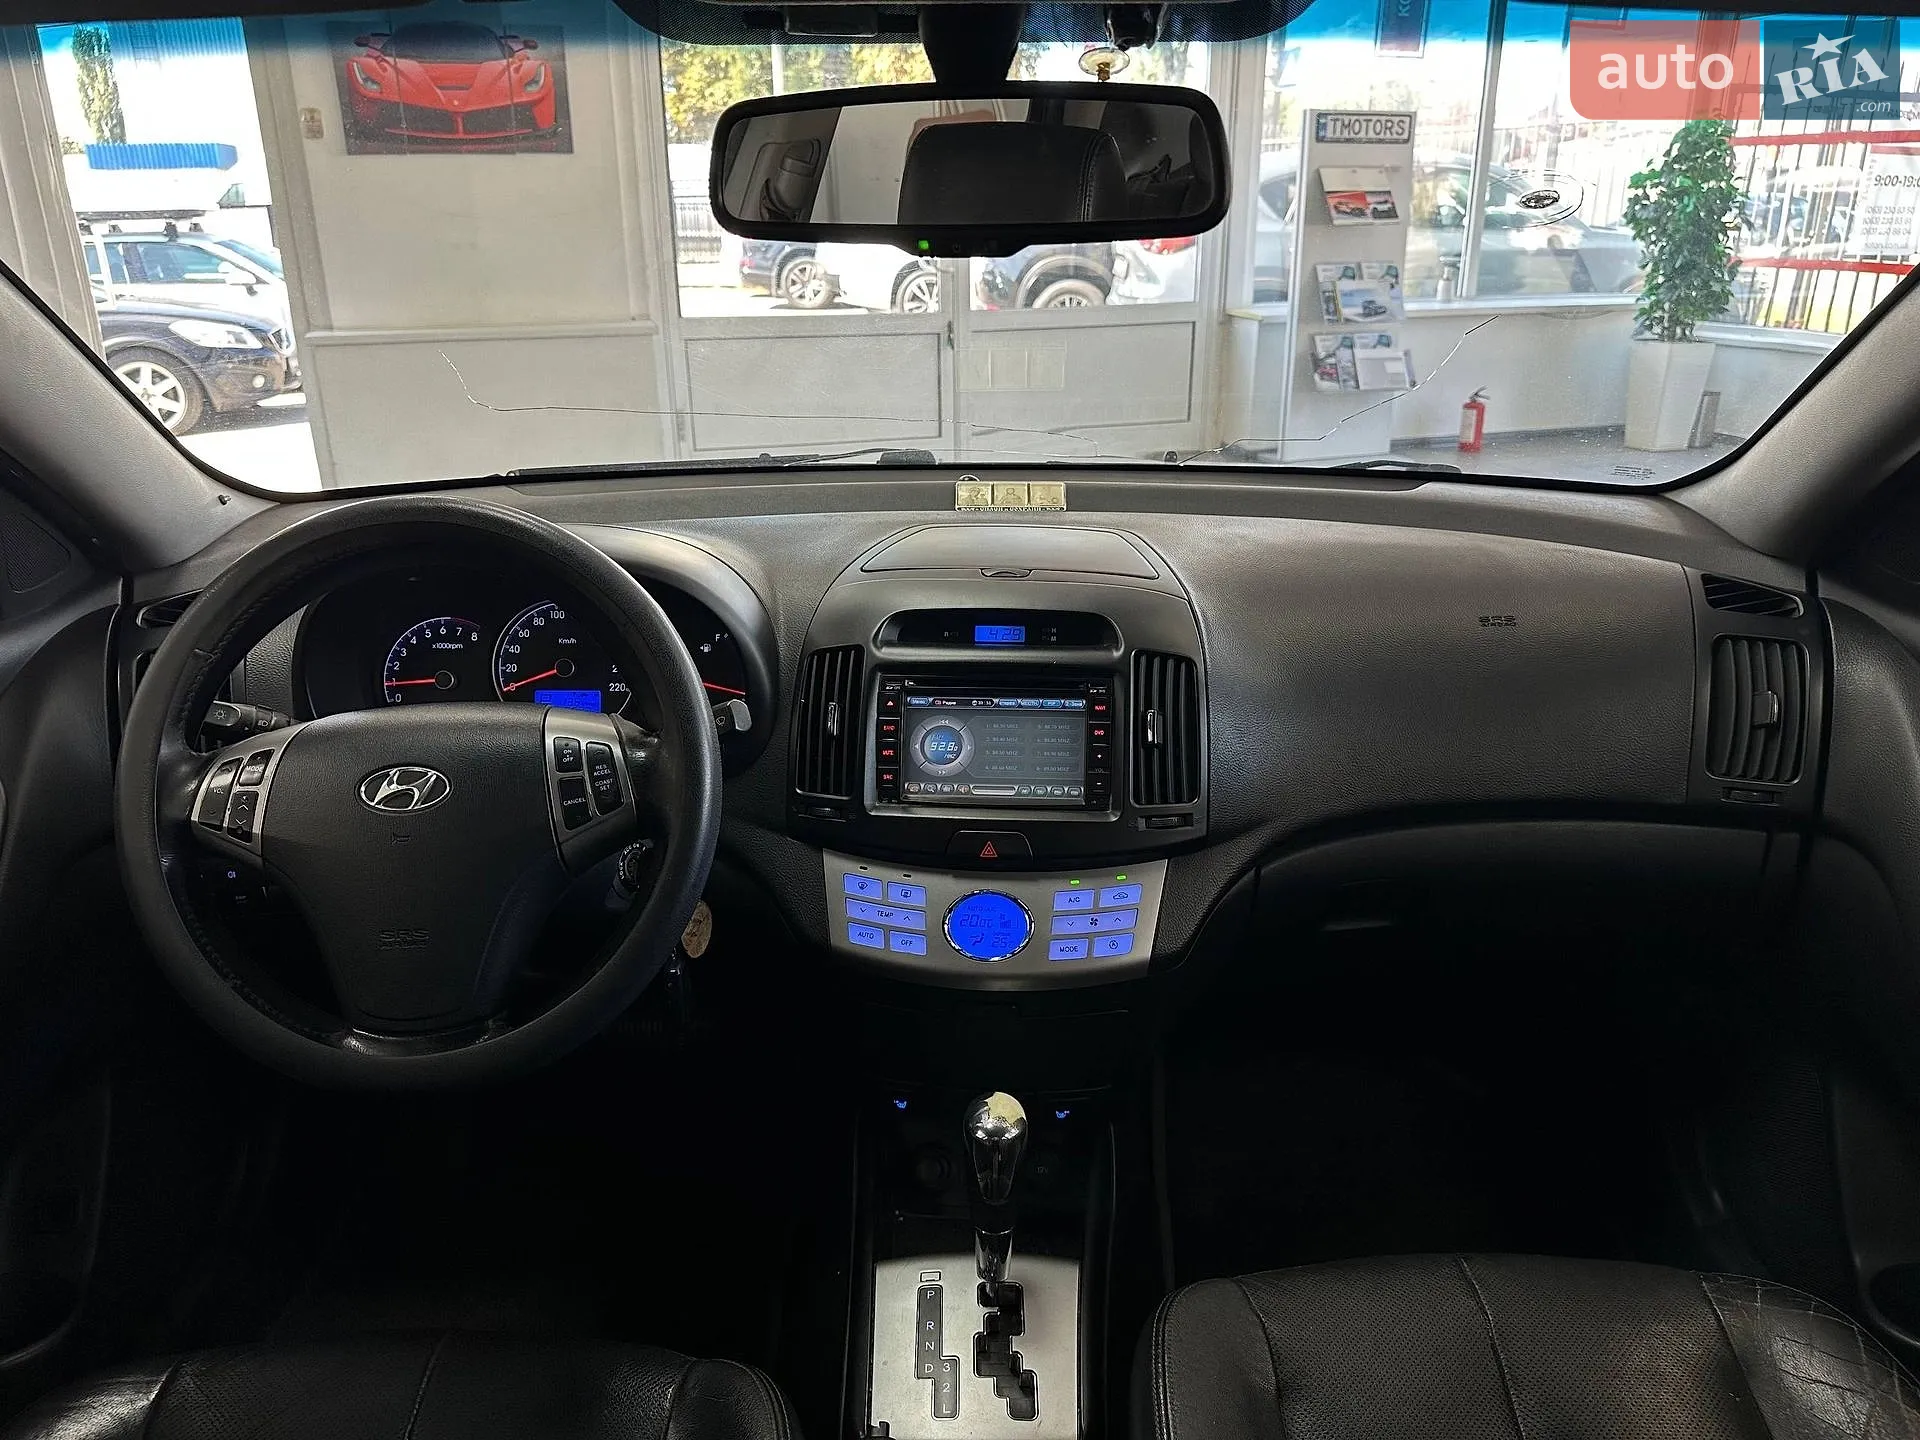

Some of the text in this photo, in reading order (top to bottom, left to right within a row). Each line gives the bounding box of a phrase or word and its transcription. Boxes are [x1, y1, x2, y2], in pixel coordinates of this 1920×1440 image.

[1329, 118, 1406, 137] TMOTORS
[549, 610, 565, 619] 100
[533, 617, 545, 626] 80
[424, 629, 432, 638] 5
[440, 626, 447, 635] 6
[456, 627, 463, 636] 7
[518, 629, 530, 638] 60
[410, 636, 417, 645] 4
[471, 632, 478, 641] 8
[715, 634, 721, 642] F
[432, 642, 463, 650] x1000rpm
[508, 644, 521, 654] 40
[400, 648, 407, 657] 3
[393, 662, 400, 670] 2
[505, 663, 518, 672] 20
[608, 683, 626, 692] 220
[395, 693, 402, 702] 0
[563, 797, 586, 806] CANCEL
[877, 910, 894, 918] TEMP
[857, 931, 874, 940] AUTO
[900, 939, 913, 947] OFF
[1059, 945, 1079, 953] MODE
[927, 1291, 935, 1299] P
[926, 1320, 935, 1330] R
[925, 1341, 935, 1350] N
[925, 1364, 934, 1372] D
[943, 1363, 950, 1372] 3
[943, 1383, 950, 1392] 2
[943, 1404, 951, 1414] L
